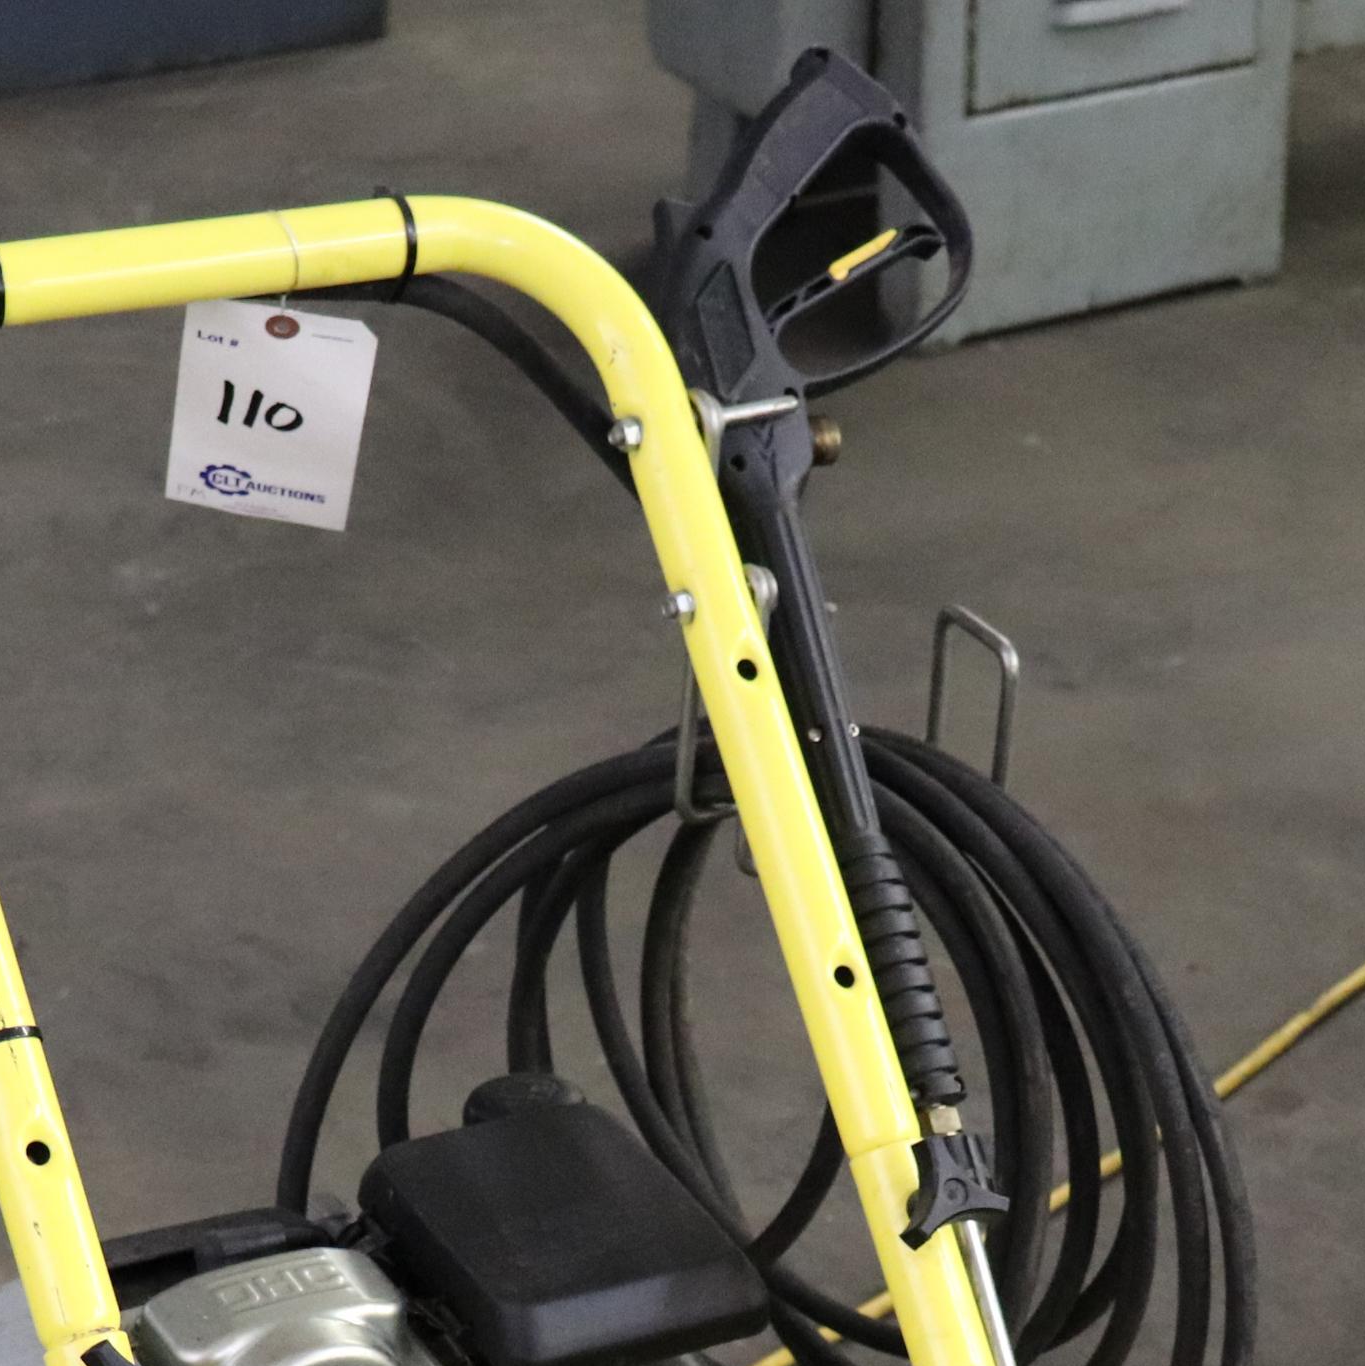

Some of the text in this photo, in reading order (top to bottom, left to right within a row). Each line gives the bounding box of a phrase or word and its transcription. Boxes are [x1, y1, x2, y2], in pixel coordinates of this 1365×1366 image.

[197, 329, 223, 345] Lot
[217, 379, 304, 432] 110
[211, 472, 326, 504] CLT AUCTIONS
